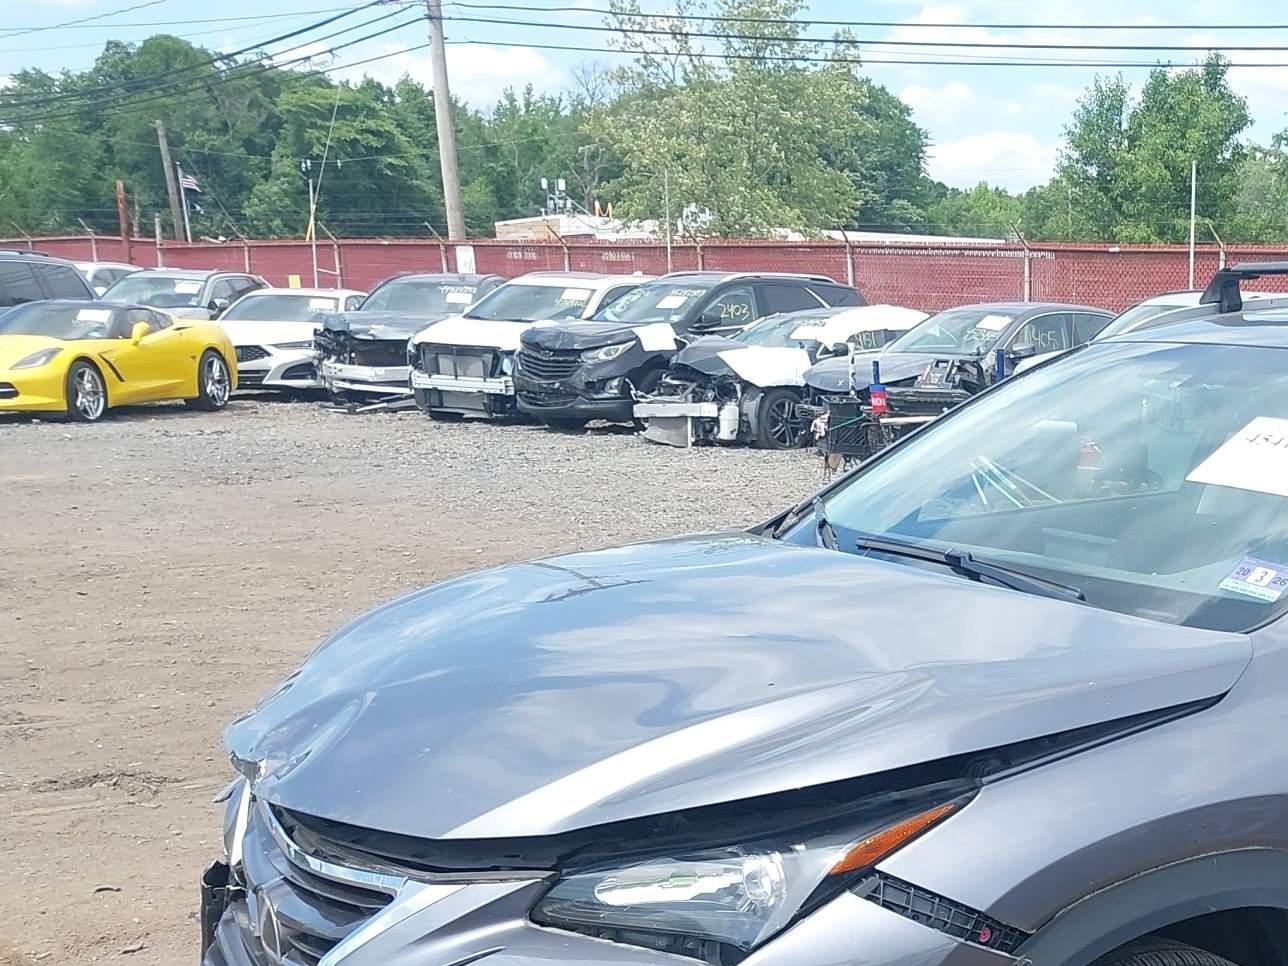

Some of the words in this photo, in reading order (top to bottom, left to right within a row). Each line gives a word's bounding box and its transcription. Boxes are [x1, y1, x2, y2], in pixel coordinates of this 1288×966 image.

[717, 303, 750, 321] 2403
[1236, 566, 1251, 577] 20
[1254, 570, 1269, 583] 3
[1272, 576, 1288, 587] 26
